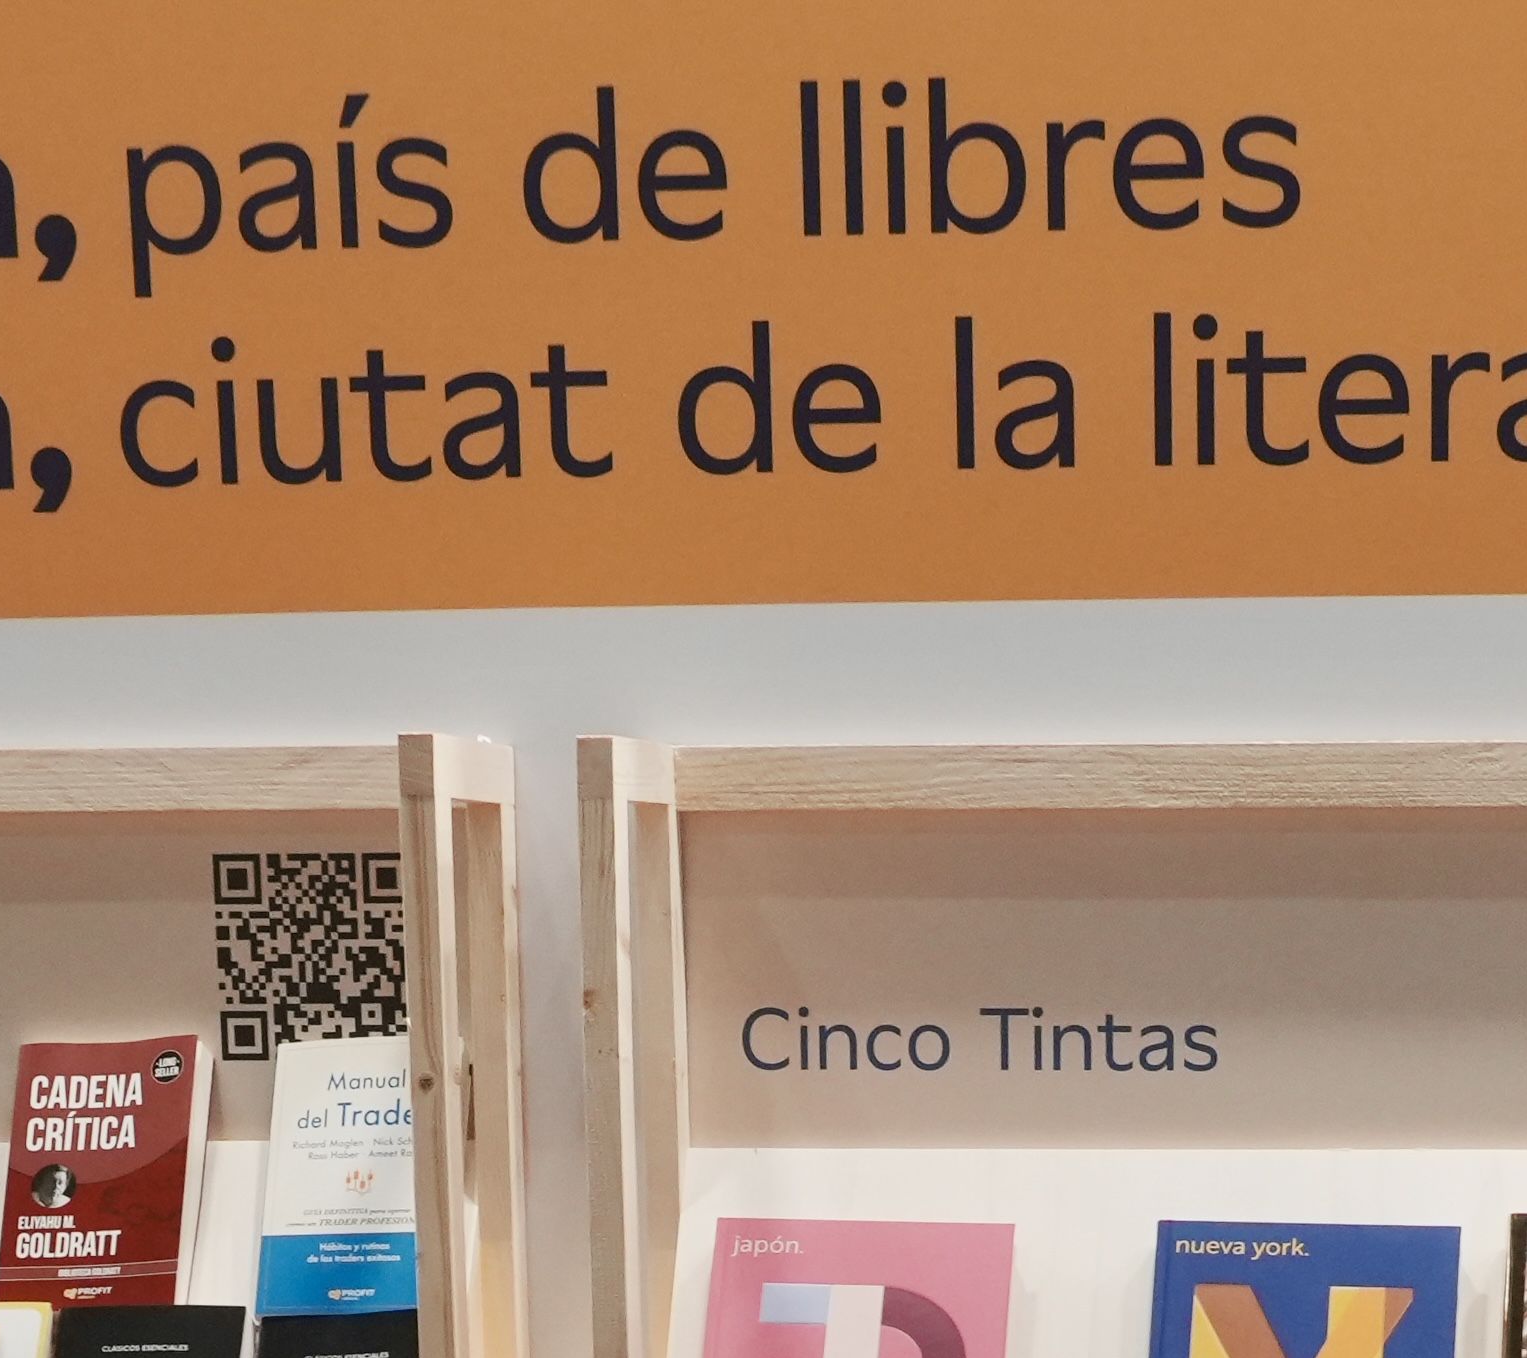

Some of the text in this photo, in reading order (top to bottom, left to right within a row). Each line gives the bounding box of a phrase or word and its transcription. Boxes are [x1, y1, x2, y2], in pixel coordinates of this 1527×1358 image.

[124, 91, 454, 297] país
[520, 86, 728, 246] de
[794, 79, 1302, 241] llibres
[119, 335, 614, 488] ciutat
[678, 320, 886, 475] de
[952, 317, 1079, 472] la
[741, 1006, 1219, 1072] Cinco Tintas
[29, 1073, 143, 1109] CADENA
[328, 1071, 406, 1094] Manual
[25, 1109, 136, 1152] CRÍTICA
[297, 1107, 329, 1130] del
[17, 1216, 60, 1230] ELIYAHU
[15, 1229, 122, 1259] GOLDRATT
[732, 1233, 804, 1258] japón.
[1175, 1235, 1310, 1261] nueva york.
